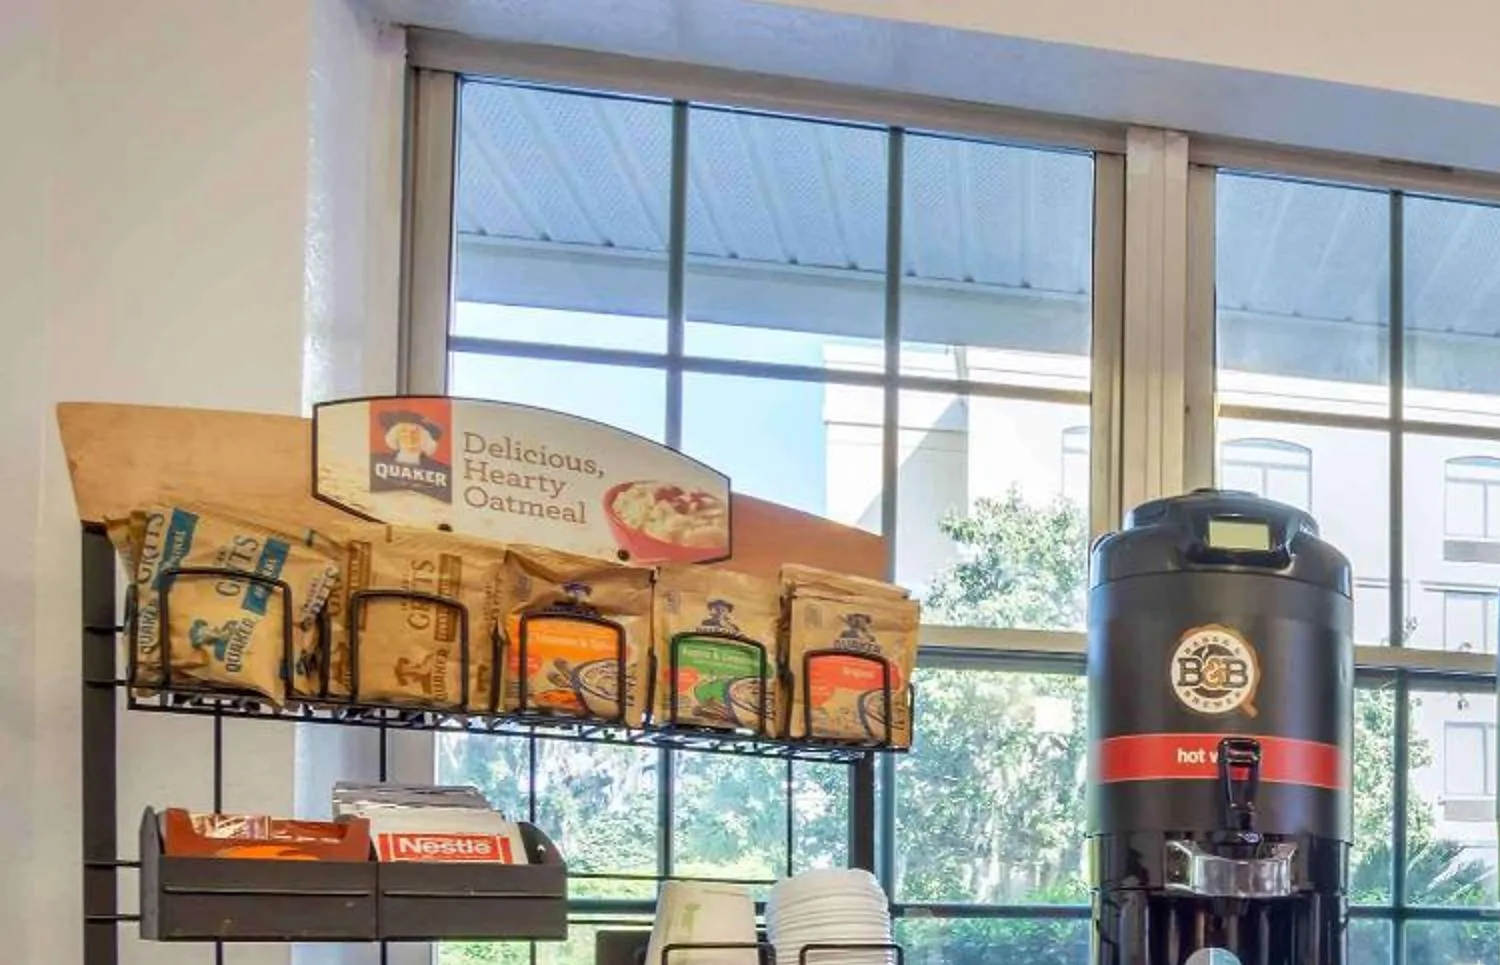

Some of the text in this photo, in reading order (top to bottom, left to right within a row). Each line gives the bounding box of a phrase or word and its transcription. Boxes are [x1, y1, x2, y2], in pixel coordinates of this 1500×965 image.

[463, 431, 605, 478] Delicious,
[374, 462, 449, 489] QUAKER
[463, 459, 567, 498] Hearty
[463, 486, 588, 525] Oatmeal
[215, 534, 260, 597] GTS
[1177, 747, 1206, 764] hot
